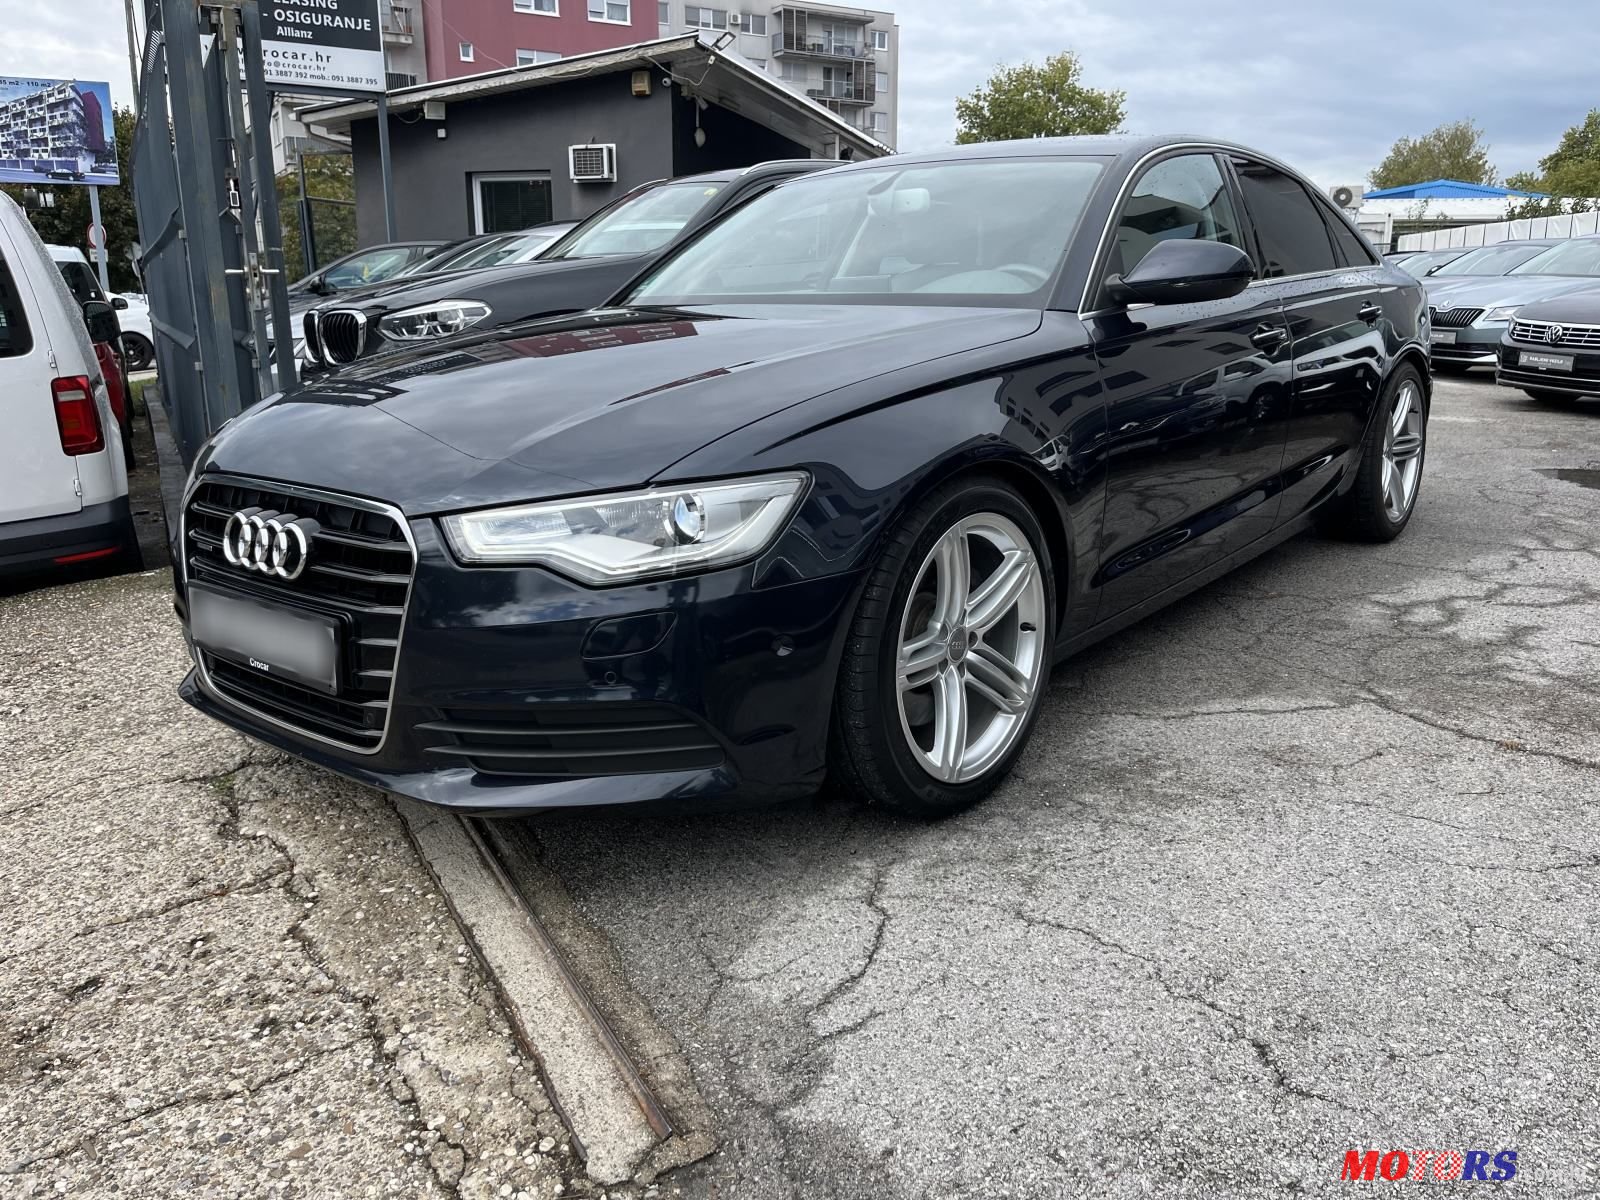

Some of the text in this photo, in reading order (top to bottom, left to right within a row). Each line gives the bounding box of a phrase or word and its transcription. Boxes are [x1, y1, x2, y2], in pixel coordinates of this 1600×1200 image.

[273, 9, 372, 31] OSIGURANJE
[276, 25, 313, 39] Allianz
[263, 48, 332, 63] rocar.hr
[275, 69, 292, 77] 3887
[295, 71, 307, 79] 392
[249, 657, 269, 672] Crocar
